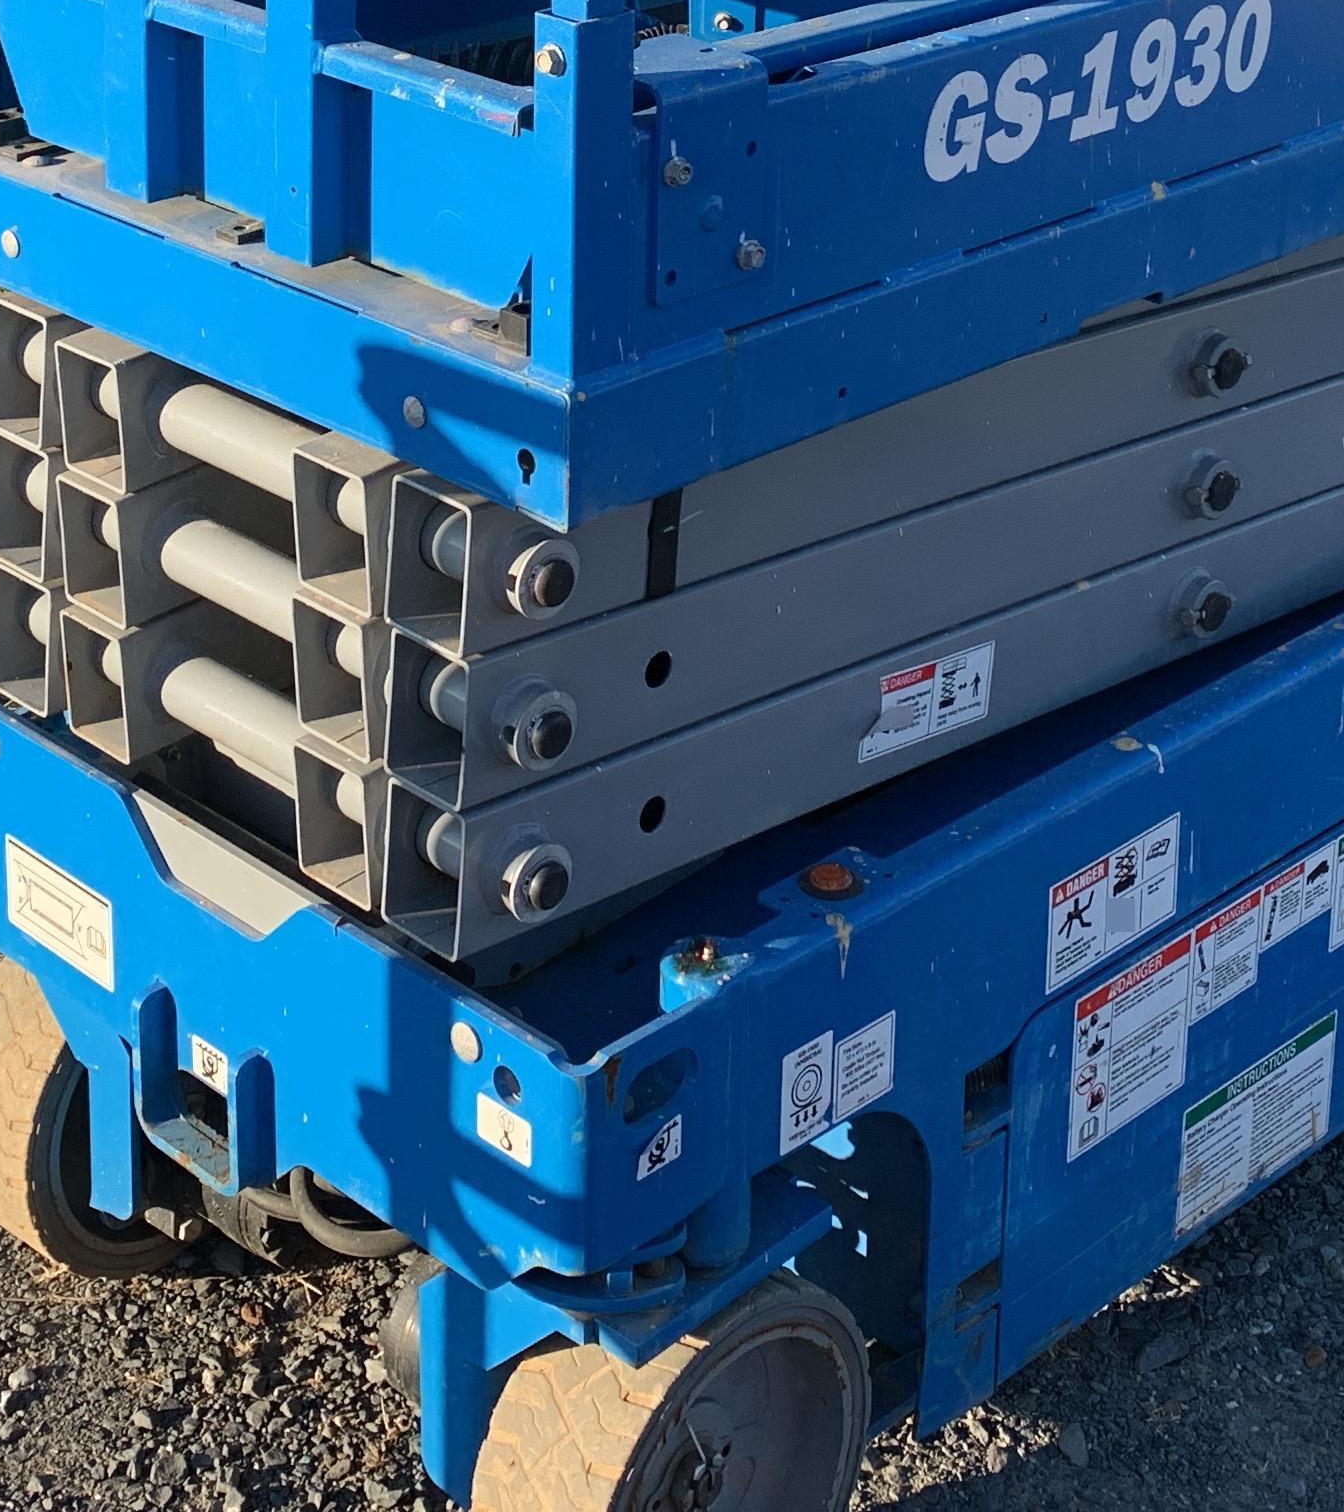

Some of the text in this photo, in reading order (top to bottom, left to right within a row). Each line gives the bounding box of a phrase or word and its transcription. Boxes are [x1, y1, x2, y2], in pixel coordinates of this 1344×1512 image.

[890, 669, 923, 690] DANGER
[1066, 862, 1106, 896] DANGER
[1218, 898, 1252, 928] DANGER
[1118, 953, 1164, 994] DANGER
[1226, 1042, 1298, 1101] INSTRUCTIONS
